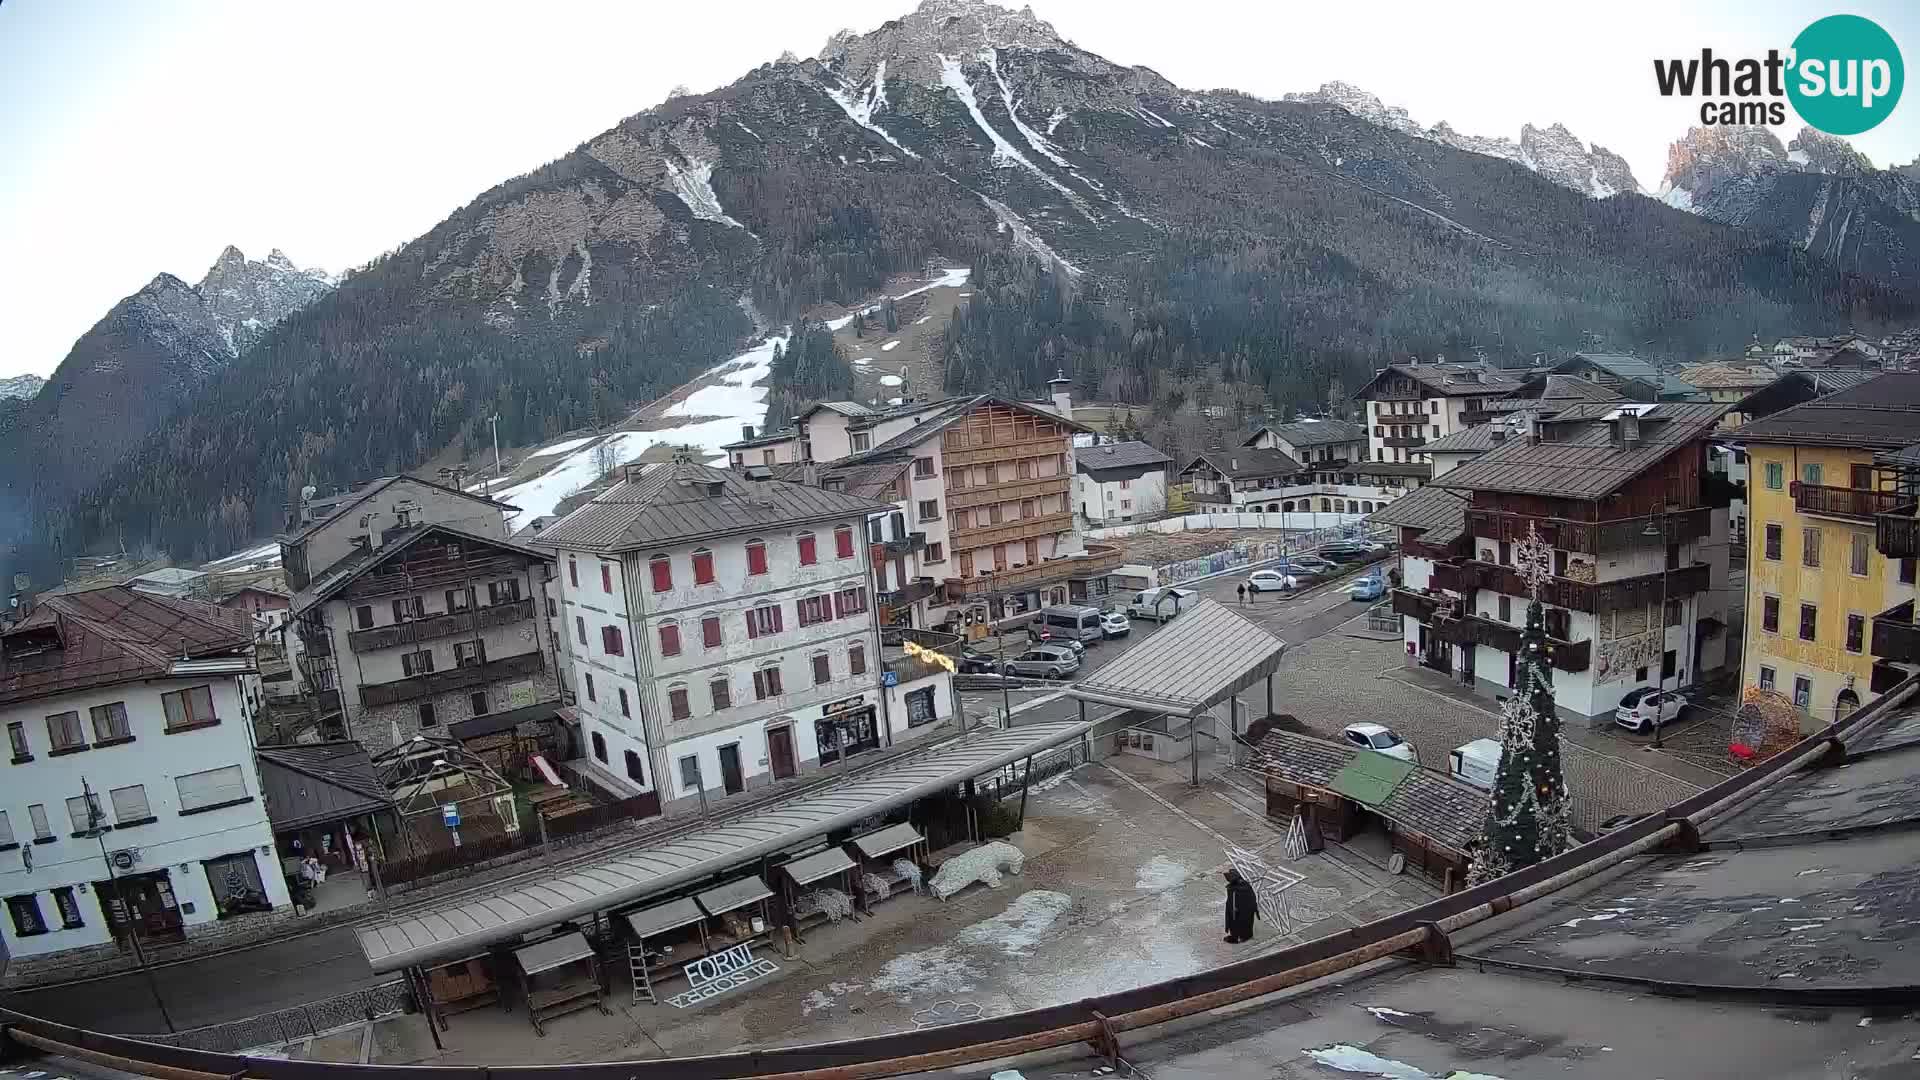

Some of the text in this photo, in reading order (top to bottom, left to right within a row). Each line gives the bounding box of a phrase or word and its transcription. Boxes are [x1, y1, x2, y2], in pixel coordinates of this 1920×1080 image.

[664, 959, 780, 1008] DI SOPRA
[684, 941, 754, 987] FORNI
